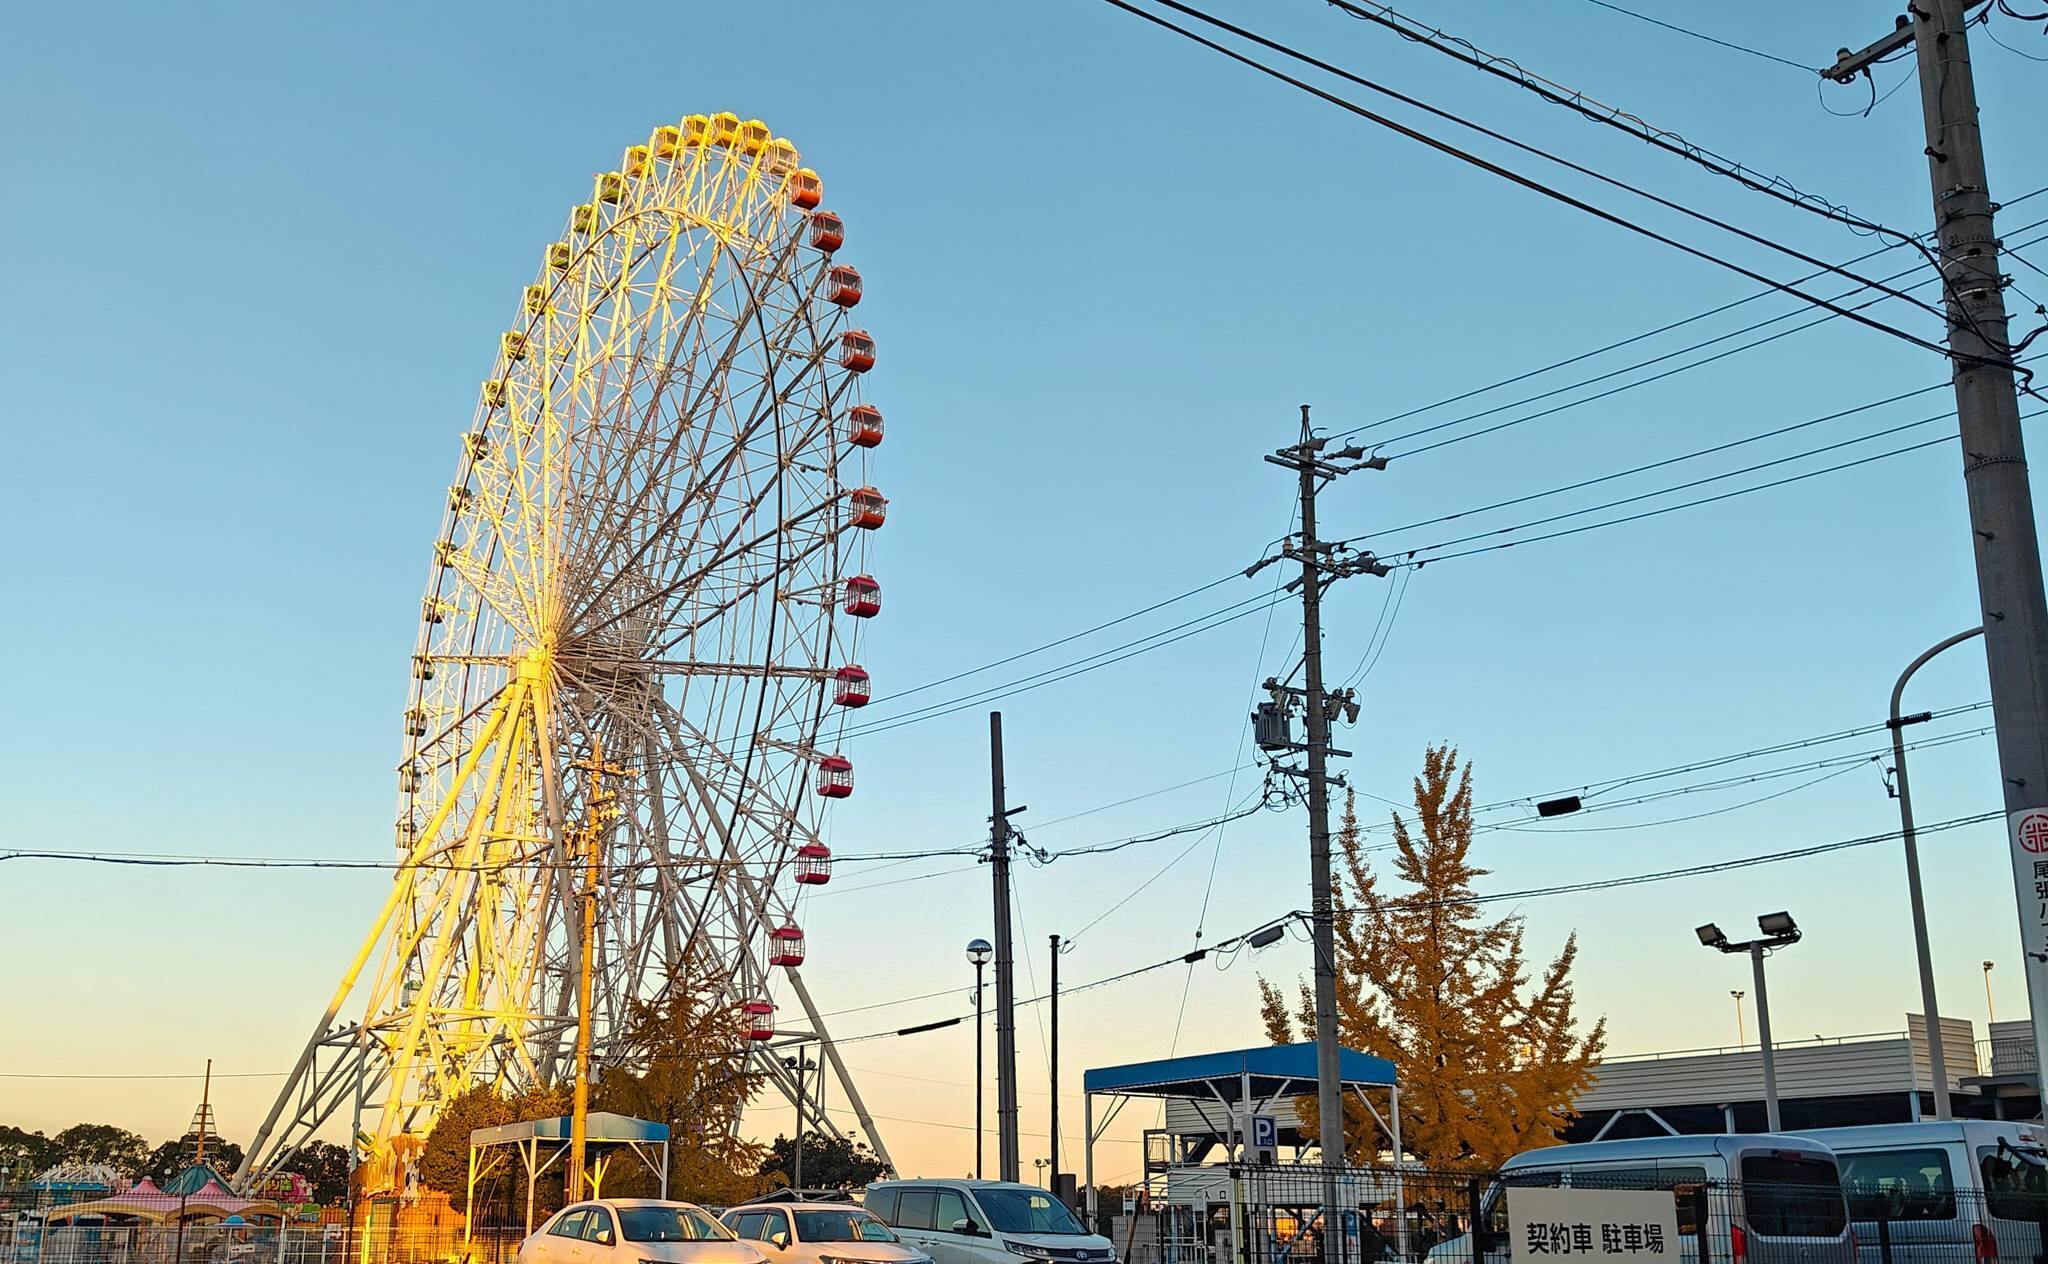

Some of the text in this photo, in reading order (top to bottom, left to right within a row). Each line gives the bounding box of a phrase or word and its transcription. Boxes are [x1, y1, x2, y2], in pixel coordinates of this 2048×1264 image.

[1256, 1119, 1271, 1146] P
[1263, 1138, 1273, 1146] 入口
[1526, 1222, 1664, 1255] 契約車 駐車場
